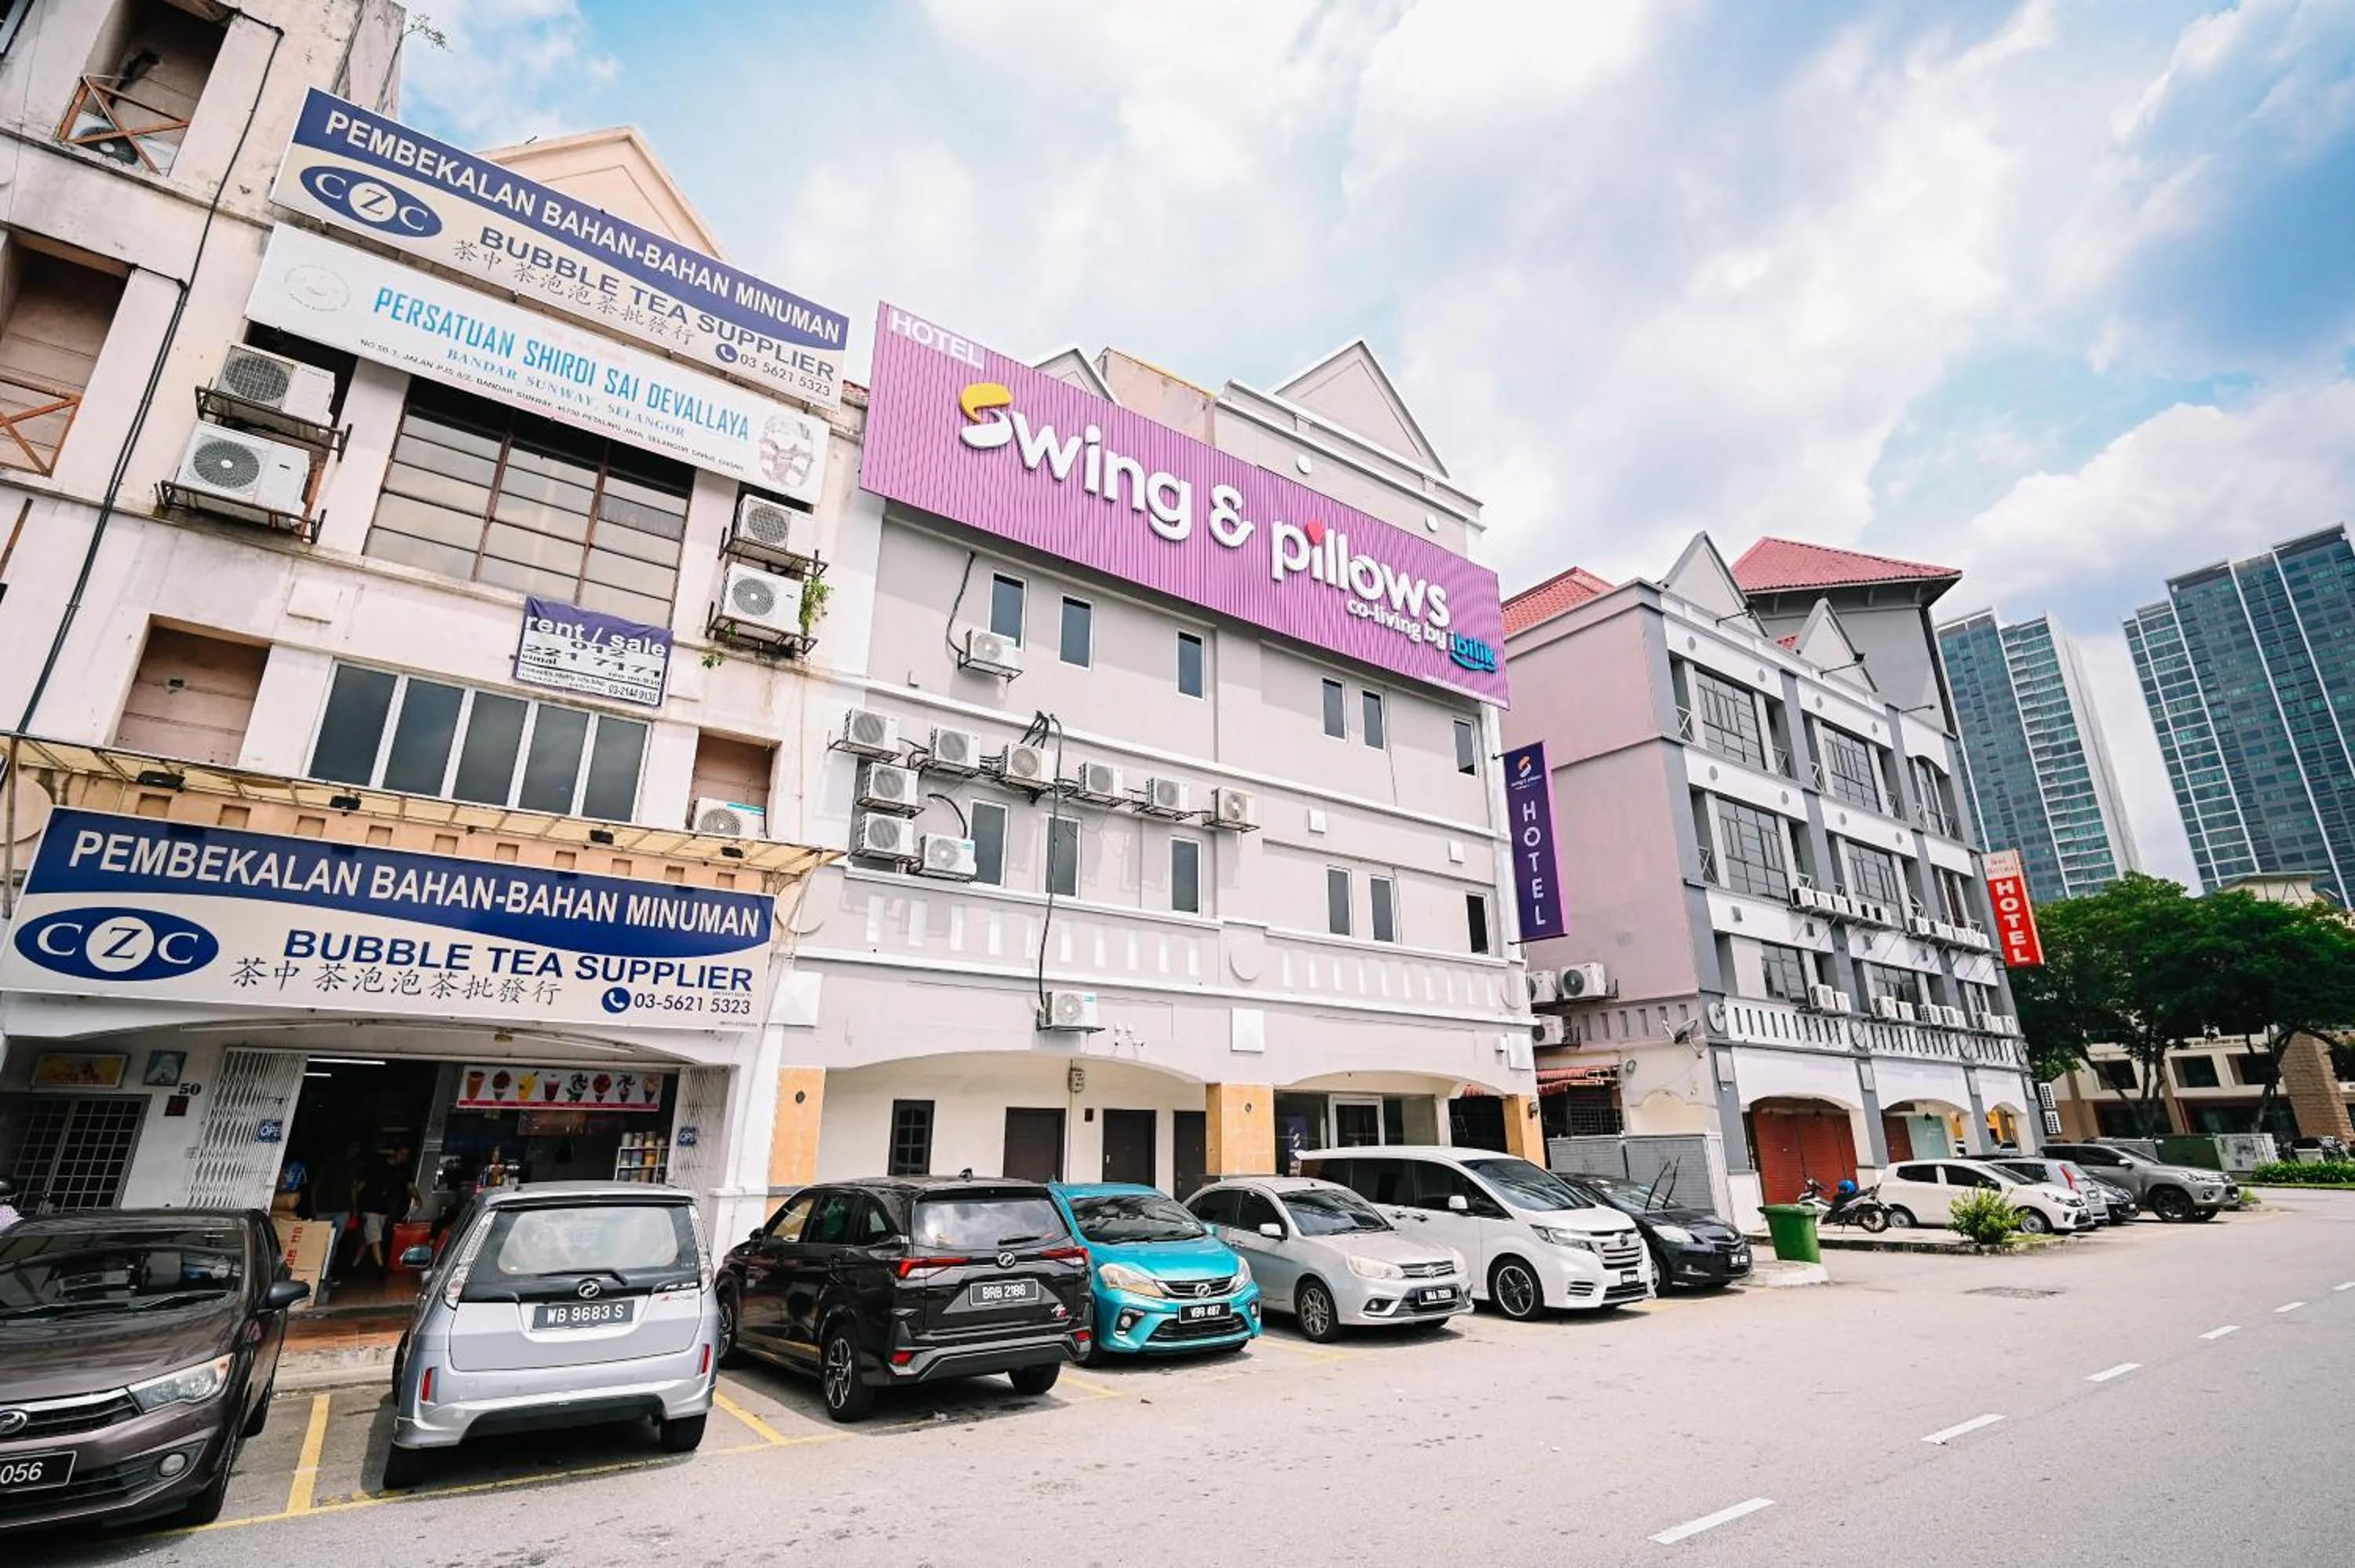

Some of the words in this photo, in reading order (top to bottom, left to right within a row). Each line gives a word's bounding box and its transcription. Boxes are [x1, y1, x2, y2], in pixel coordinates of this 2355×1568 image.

[316, 173, 429, 232] CZC
[326, 110, 536, 217] PEMBEKALAN
[542, 200, 730, 298] BAHAN-BAHAN
[735, 282, 841, 345] MINUMAN
[480, 225, 619, 294] BUBBLE
[630, 284, 688, 324] TEA
[697, 314, 835, 381] SUPPLIER
[374, 286, 516, 360] PERSATUAN
[523, 338, 597, 388] SHIRDI
[604, 366, 640, 402] SAI
[647, 383, 750, 441] DEVALLAYA
[890, 309, 984, 371] HOTEL
[447, 348, 518, 381] BANDAR
[608, 403, 685, 438] SELANGOR
[740, 353, 758, 368] 03
[762, 359, 794, 382] 5621
[798, 376, 831, 396] 5323
[1209, 484, 1254, 549] &
[1272, 520, 1451, 628] pillows
[526, 615, 585, 640] rent
[610, 633, 666, 658] sale
[1347, 599, 1422, 643] co-living
[1424, 620, 1447, 651] by
[68, 830, 363, 899] PEMBEKALAN
[368, 864, 619, 925] BAHAN-BAHAN
[625, 893, 760, 939] MINUMAN
[1522, 800, 1546, 926] HOTEL
[37, 921, 199, 965] CZC
[1995, 880, 2031, 964] HOTEL
[283, 928, 473, 971] BUBBLE
[487, 946, 564, 979] TEA
[575, 954, 754, 992] SUPPLIER
[633, 994, 703, 1012] 03-5621
[710, 997, 751, 1015] 5323
[177, 1082, 202, 1096] 50
[260, 1125, 281, 1137] OPE
[547, 1308, 567, 1324] WB
[571, 1305, 611, 1322] 9683
[615, 1304, 624, 1318] S
[0, 1462, 43, 1484] 056
